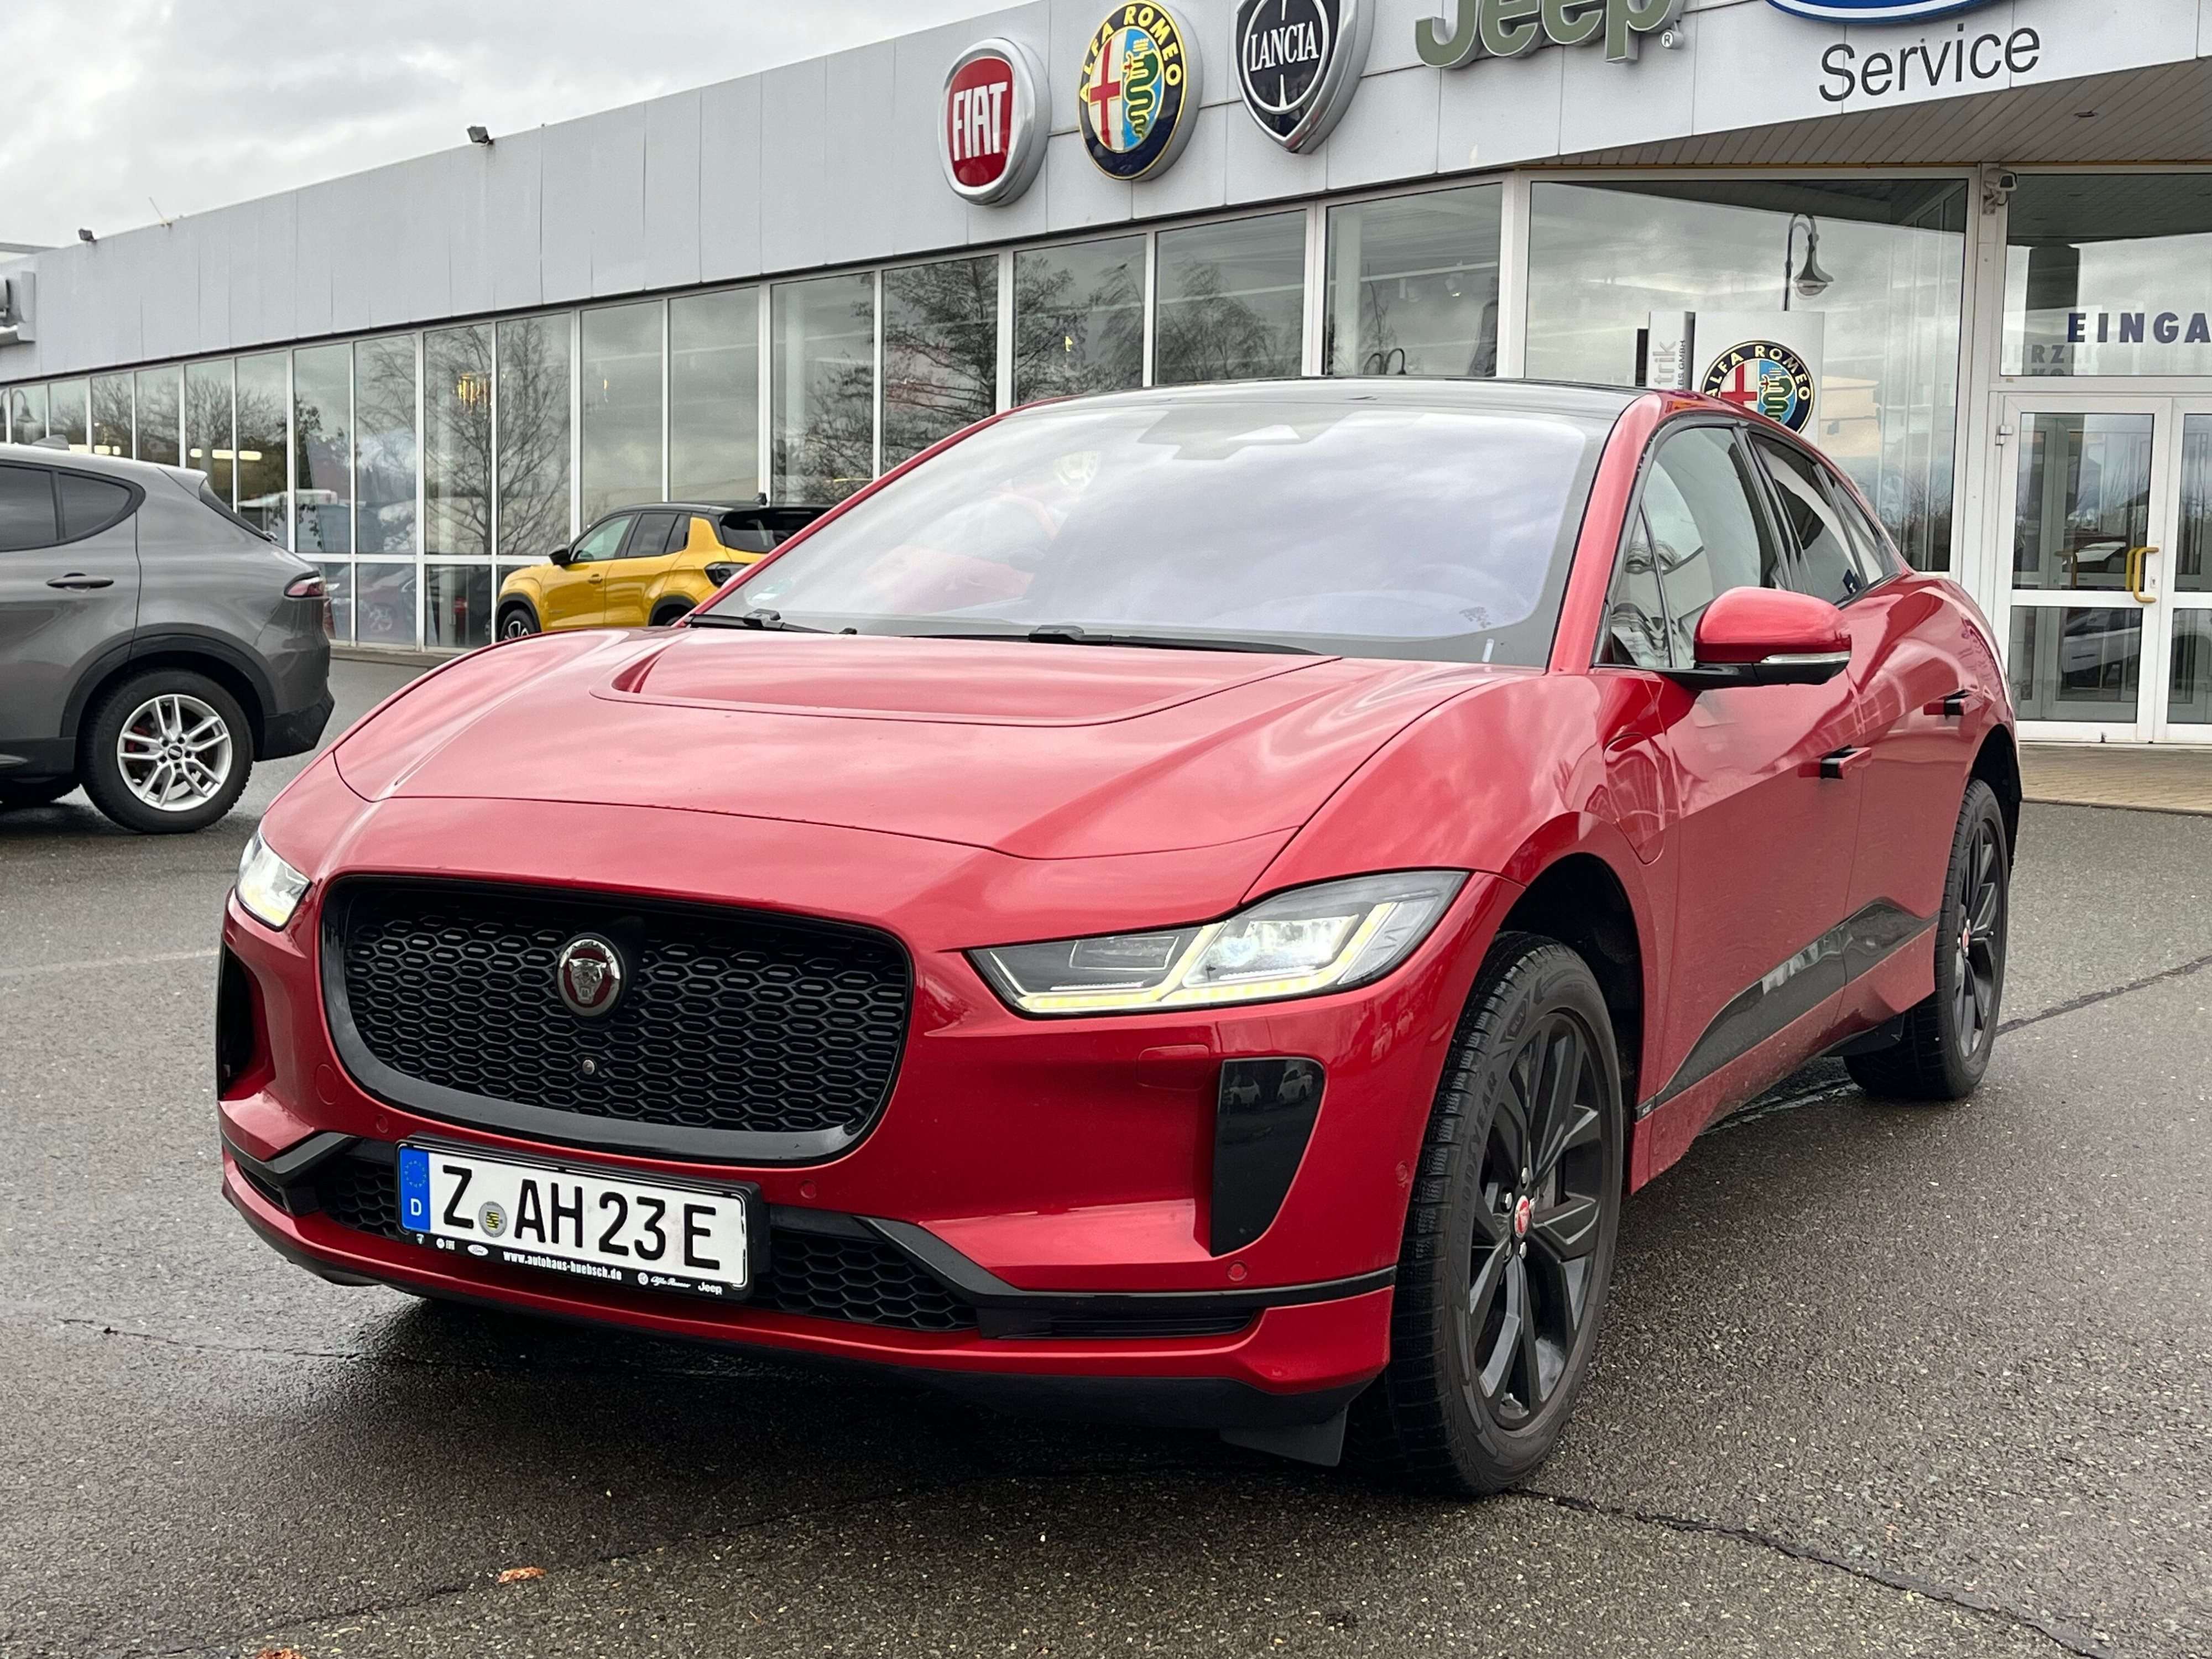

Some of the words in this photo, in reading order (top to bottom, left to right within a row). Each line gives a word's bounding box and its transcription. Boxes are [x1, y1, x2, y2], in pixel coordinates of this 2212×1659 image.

[1080, 22, 1114, 102] ALFA
[1124, 6, 1182, 86] ROMEO
[1250, 21, 1319, 71] LANCIA
[1415, 0, 1673, 67] Jeep
[1819, 23, 2040, 102] Service
[953, 82, 1008, 161] FIAT
[1705, 352, 1744, 398] ALFA
[1755, 346, 1810, 400] ROMEO
[410, 1198, 422, 1217] D
[442, 1165, 474, 1229] Z
[503, 1250, 622, 1281] www.autohaus-huebsch.de
[697, 1281, 723, 1295] Jeep
